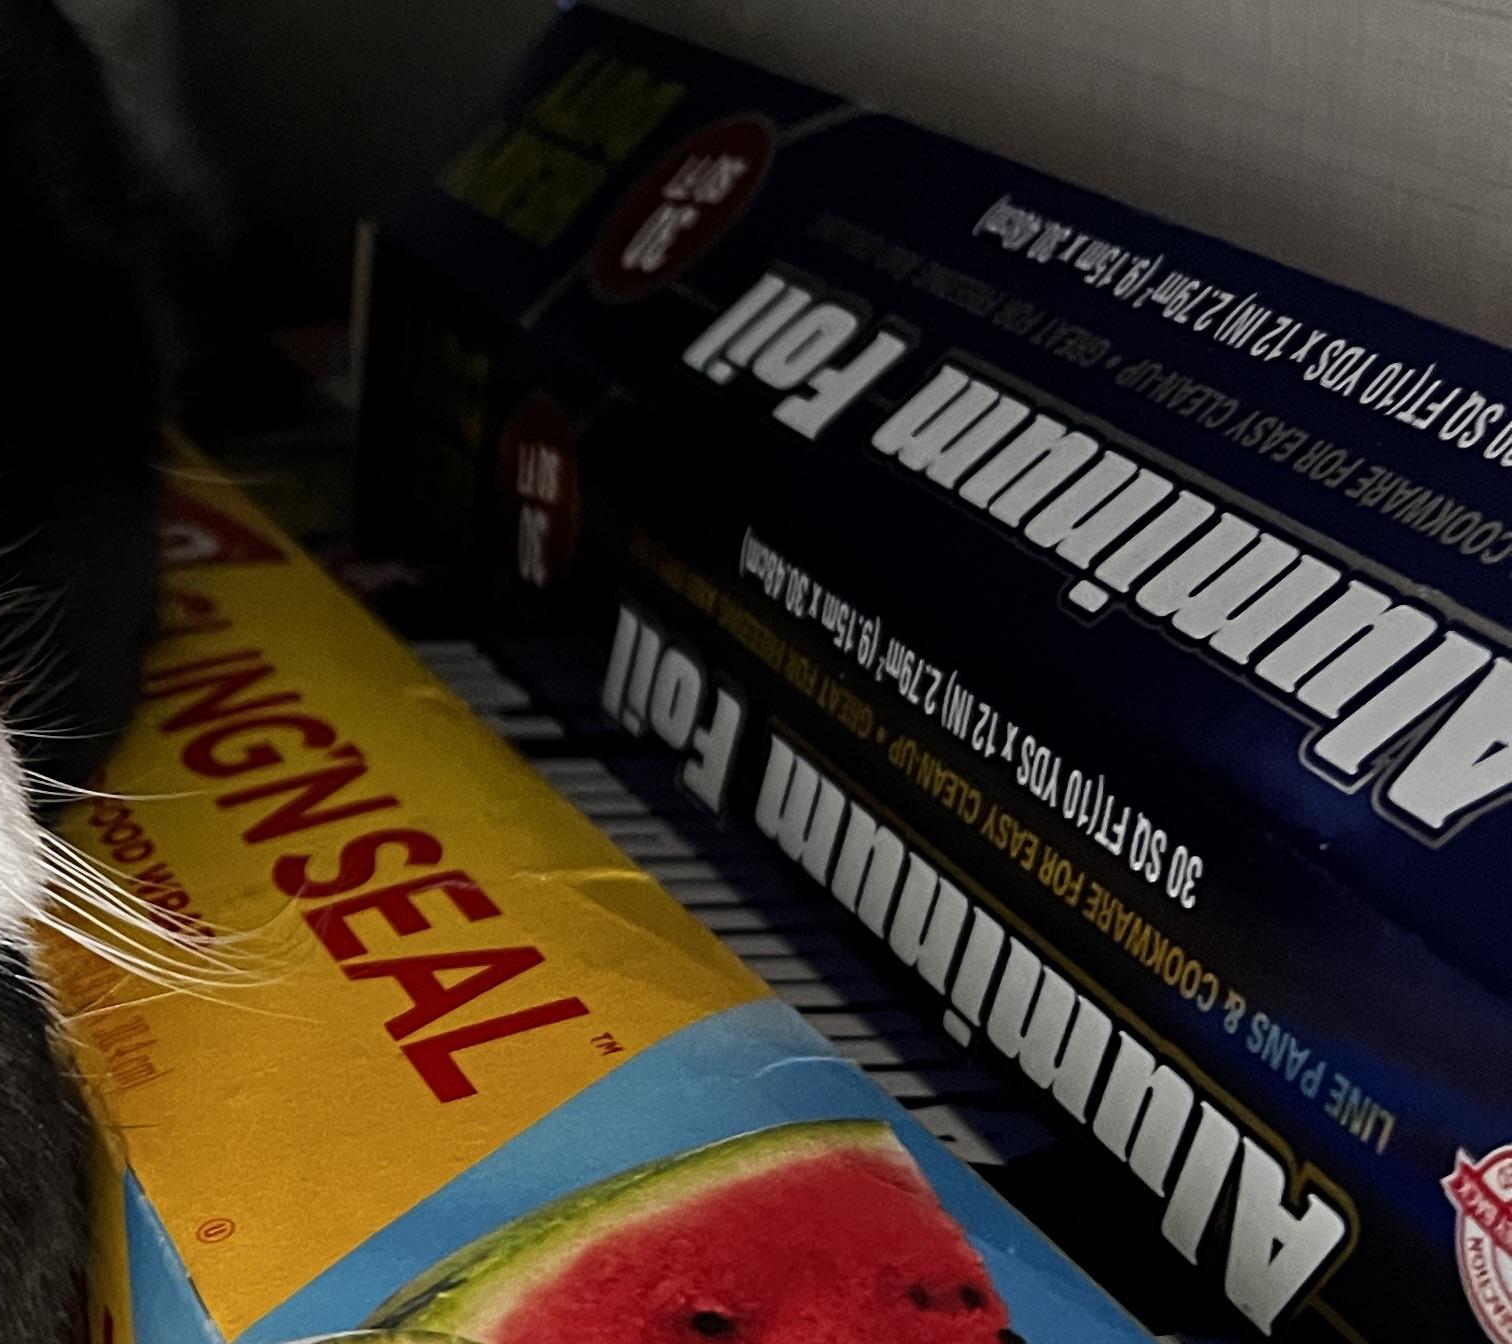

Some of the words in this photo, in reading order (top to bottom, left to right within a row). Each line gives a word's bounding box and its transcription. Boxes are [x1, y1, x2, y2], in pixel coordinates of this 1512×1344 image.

[1212, 292, 1273, 349] IN)
[1249, 316, 1304, 362] 12
[682, 272, 908, 442] Foil
[1302, 338, 1380, 398] YDS
[1223, 409, 1310, 463] EASY
[1438, 390, 1506, 449] SQ
[1291, 439, 1367, 489] FOR
[1345, 465, 1512, 565] COOKWARE
[871, 360, 1512, 829] Aluminum
[600, 605, 743, 814] Foil
[941, 670, 975, 741] IN)
[971, 702, 1000, 758] 12
[889, 735, 984, 825] CLEAN-UP
[1016, 735, 1063, 808] YDS
[980, 797, 1041, 871] EASY
[1129, 811, 1168, 883] SQ
[1037, 843, 1086, 908] FOR
[1165, 844, 1204, 909] 30
[272, 828, 589, 1103] SEAL
[1083, 881, 1220, 1012] COOKWARE
[754, 733, 1347, 1337] Aluminum
[1223, 988, 1247, 1034] &
[1245, 1010, 1328, 1099] PANS
[1324, 1072, 1397, 1155] LINE
